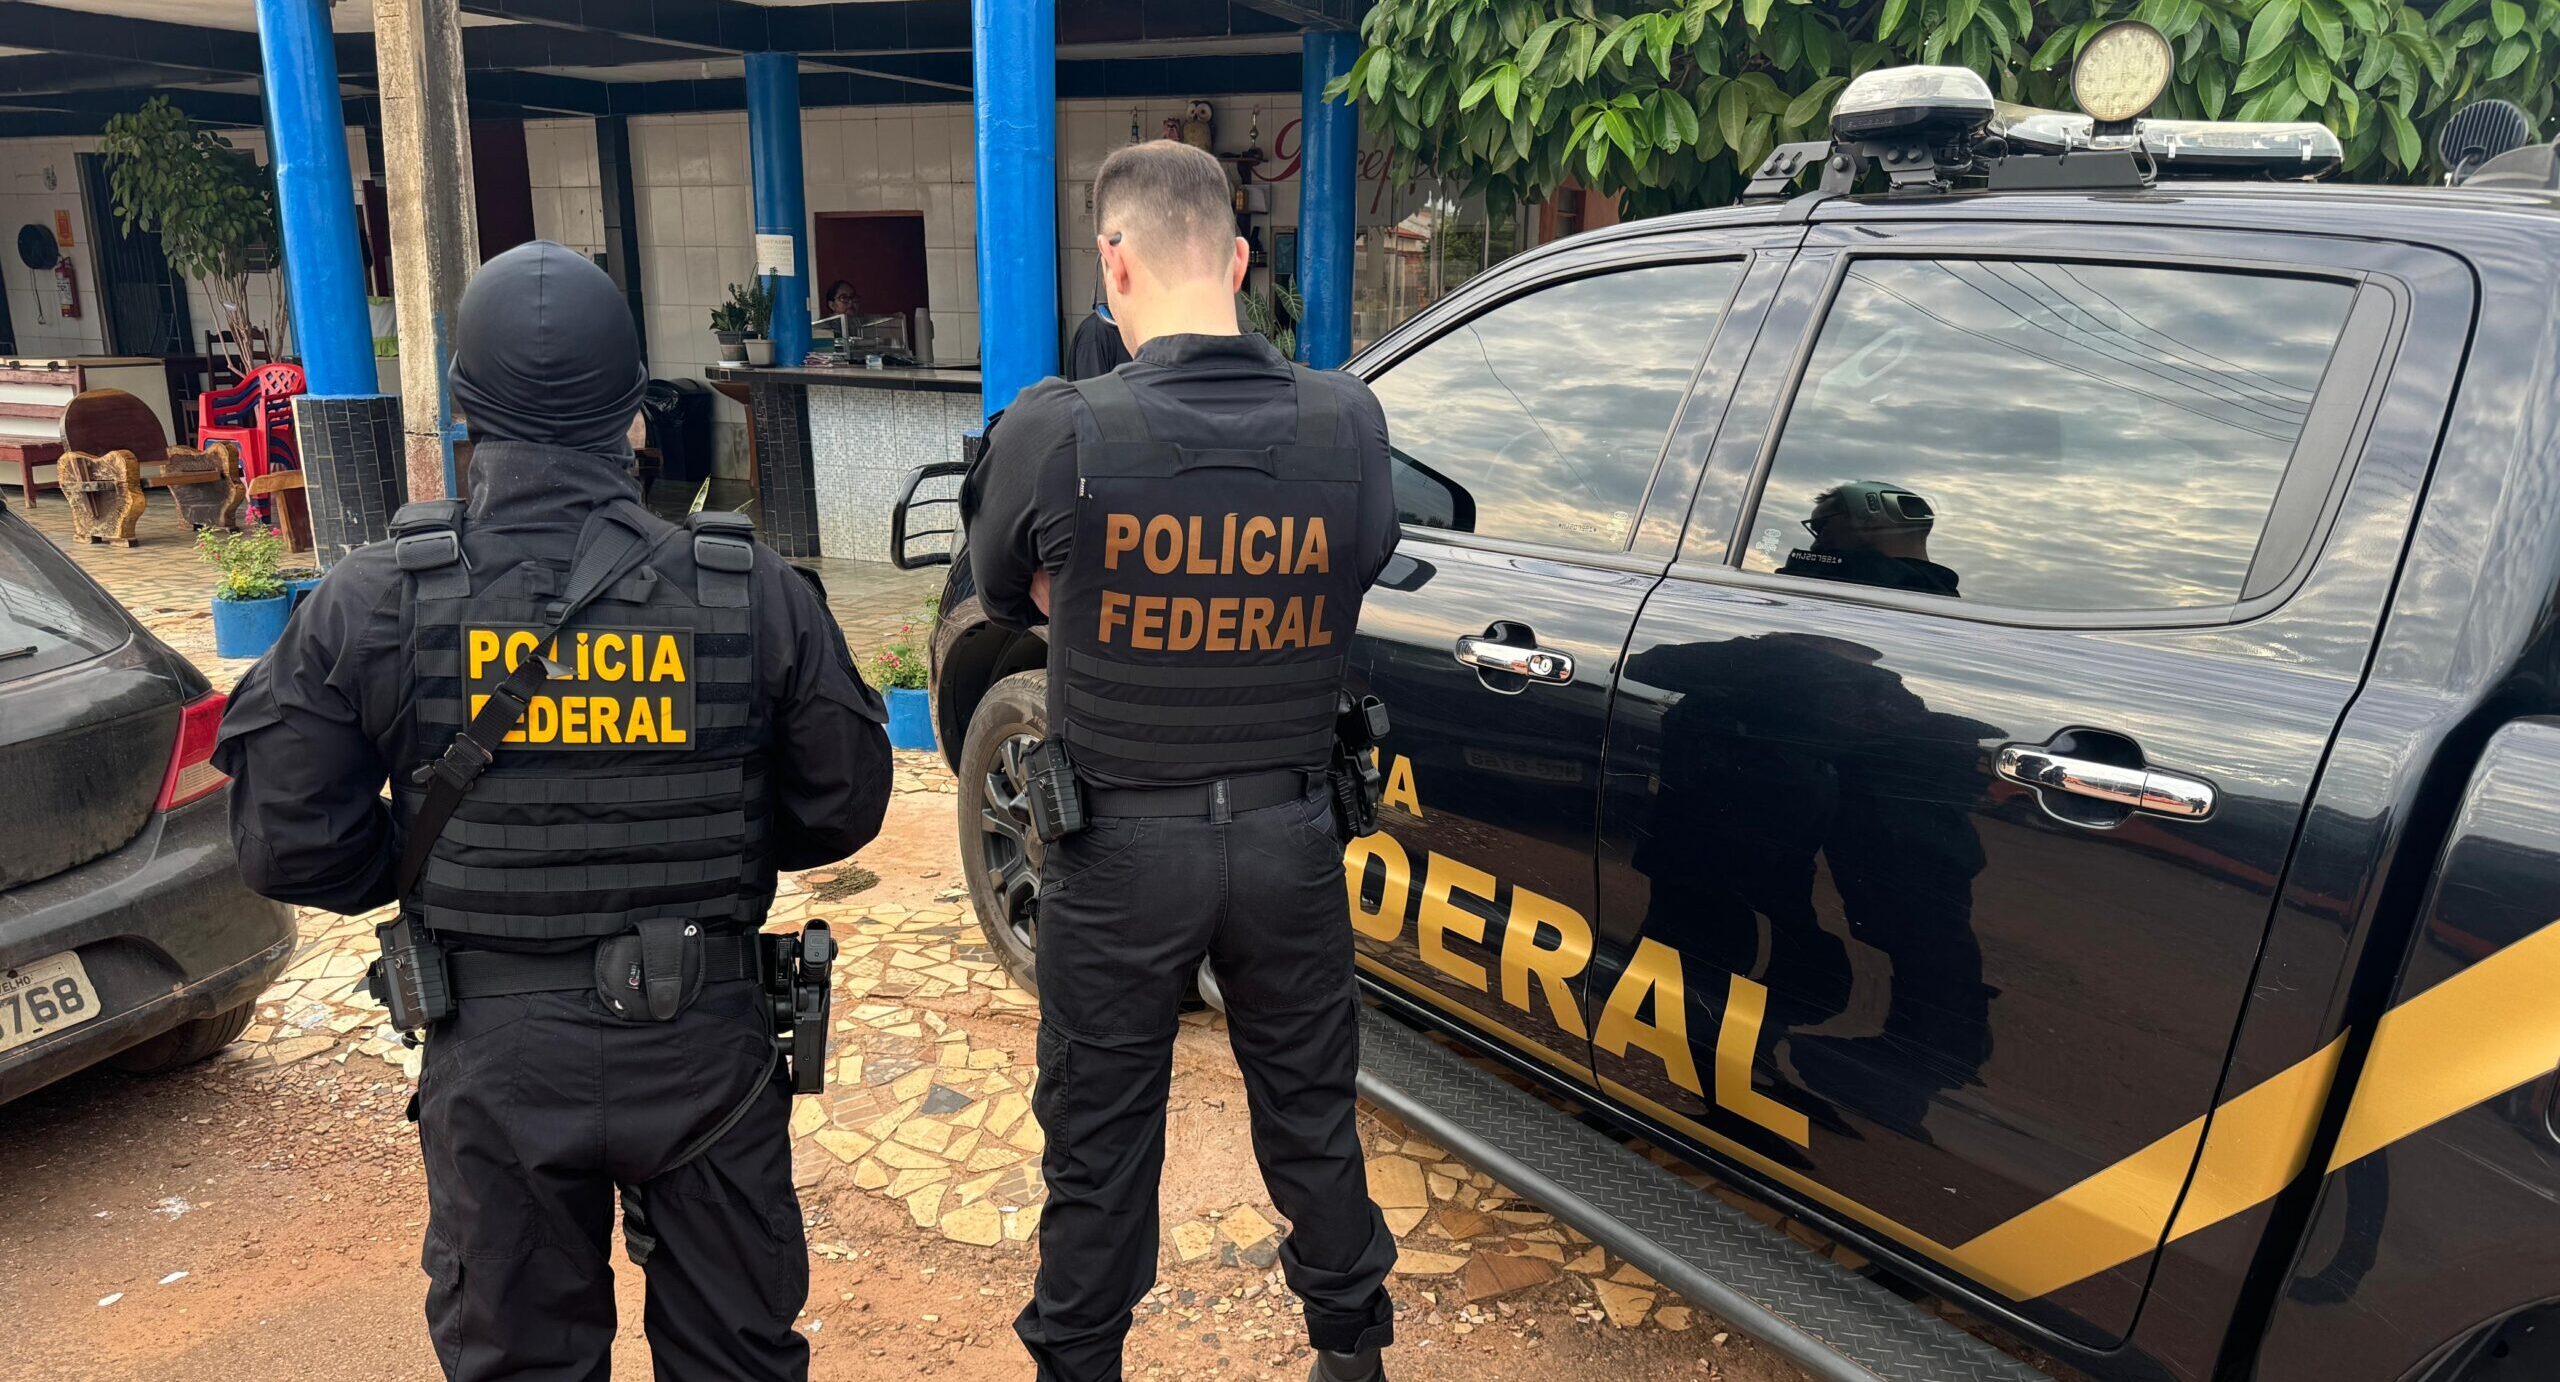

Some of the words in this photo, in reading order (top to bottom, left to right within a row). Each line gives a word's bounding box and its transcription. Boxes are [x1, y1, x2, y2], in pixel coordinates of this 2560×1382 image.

[1104, 512, 1330, 576] POLÍCIA
[1098, 590, 1333, 652] FEDERAL
[0, 977, 85, 1040] 768
